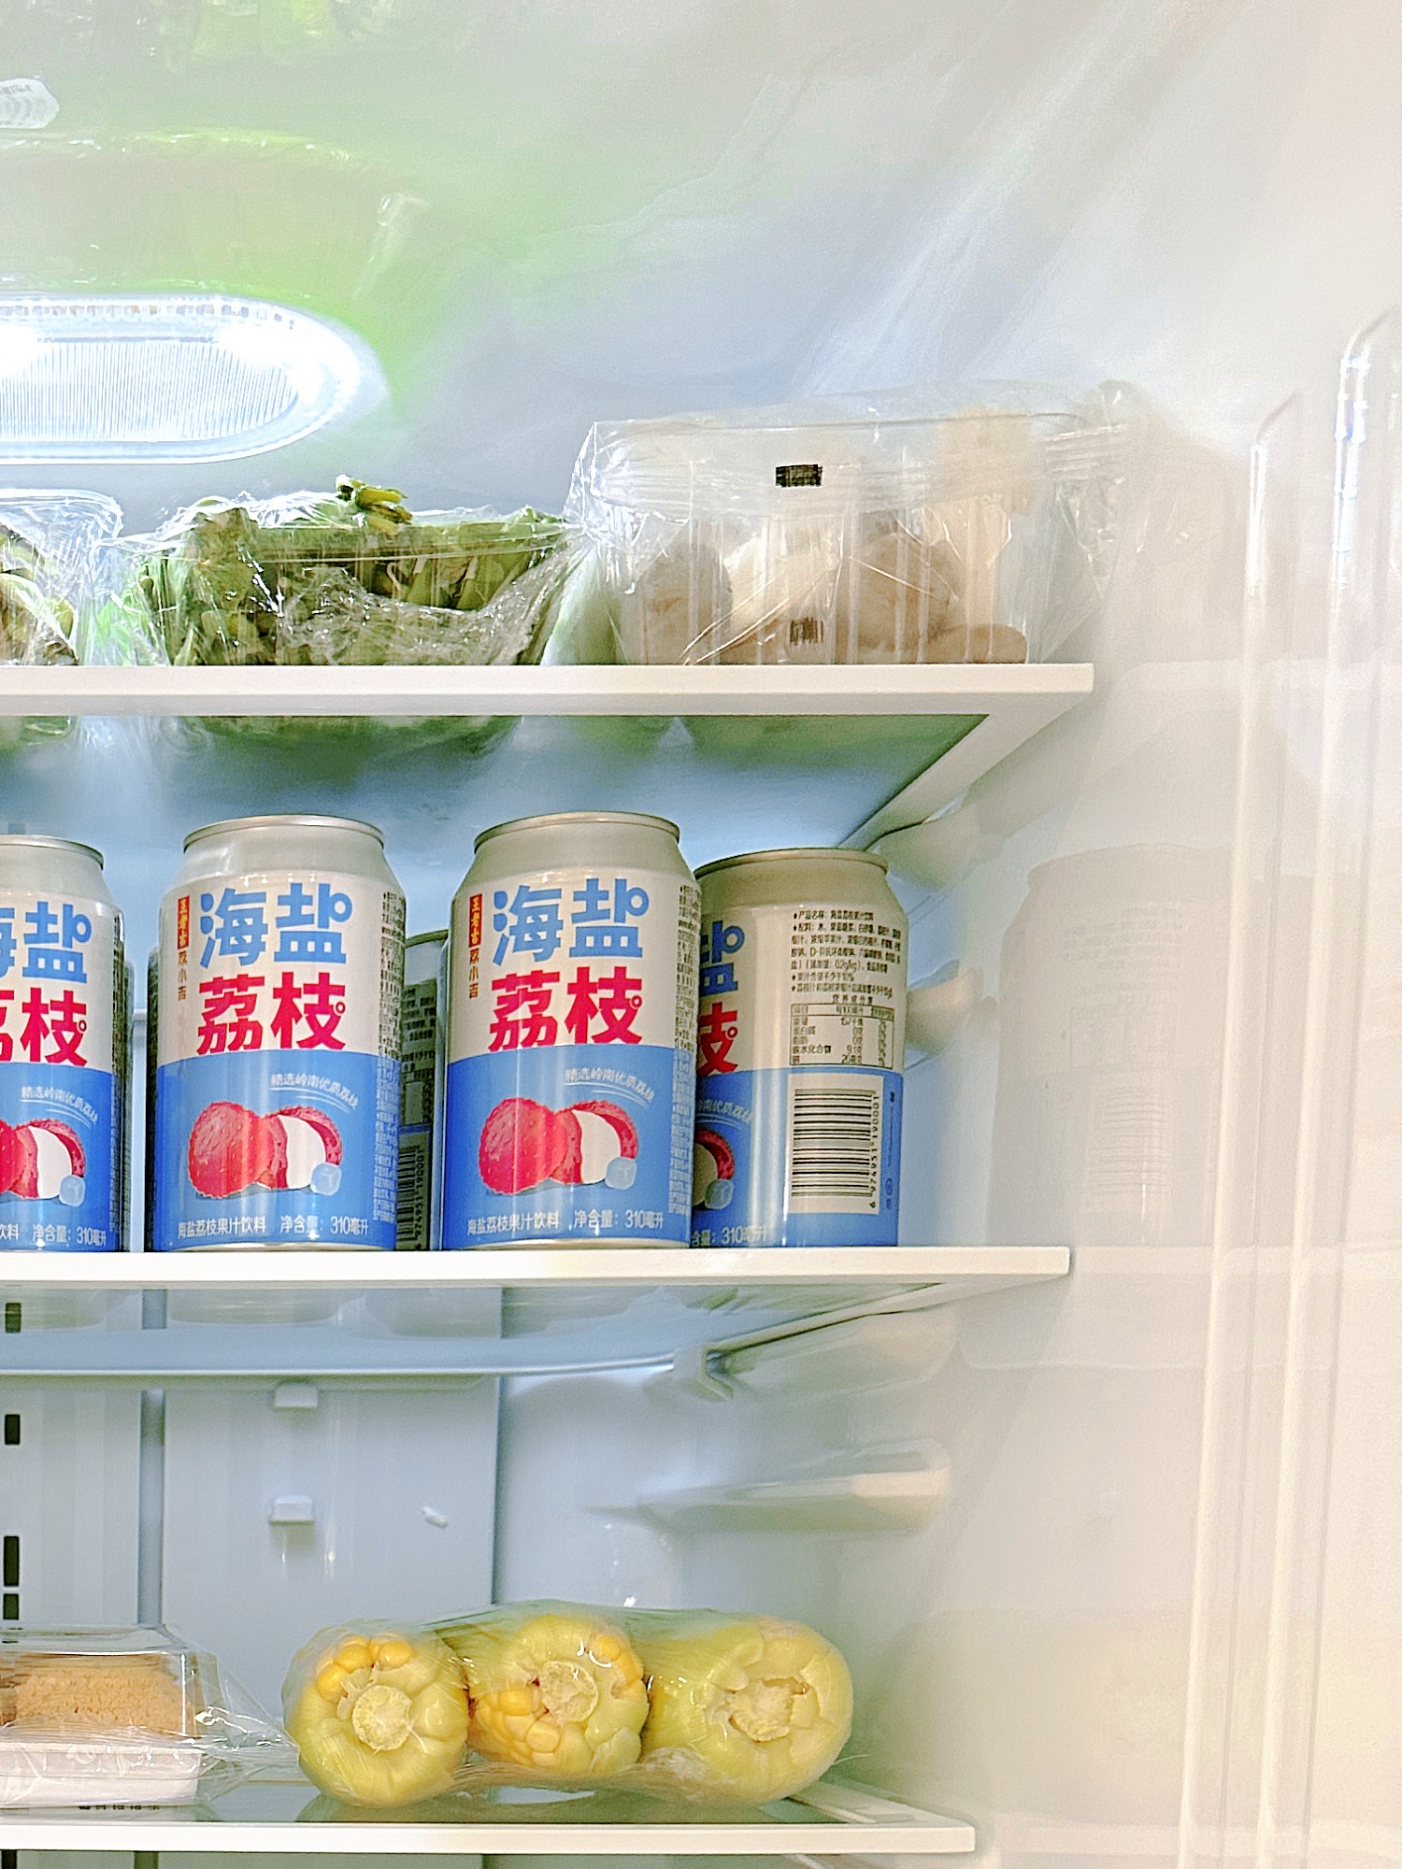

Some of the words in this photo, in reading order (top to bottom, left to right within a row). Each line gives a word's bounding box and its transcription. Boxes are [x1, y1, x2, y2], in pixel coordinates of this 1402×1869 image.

[199, 883, 352, 969] 海盐
[493, 878, 650, 965] 海盐
[197, 972, 347, 1053] 荔枝
[489, 966, 644, 1052] 荔枝
[871, 1095, 879, 1139] 190001
[869, 1148, 878, 1193] 974951
[32, 1224, 107, 1247] 净含量:310毫升
[178, 1215, 267, 1239] 海盐荔枝果汁饮料
[280, 1215, 369, 1237] 净含量:310毫升
[467, 1210, 560, 1236] 海盐荔枝果汁饮料
[573, 1208, 664, 1230] 净含量:310毫升
